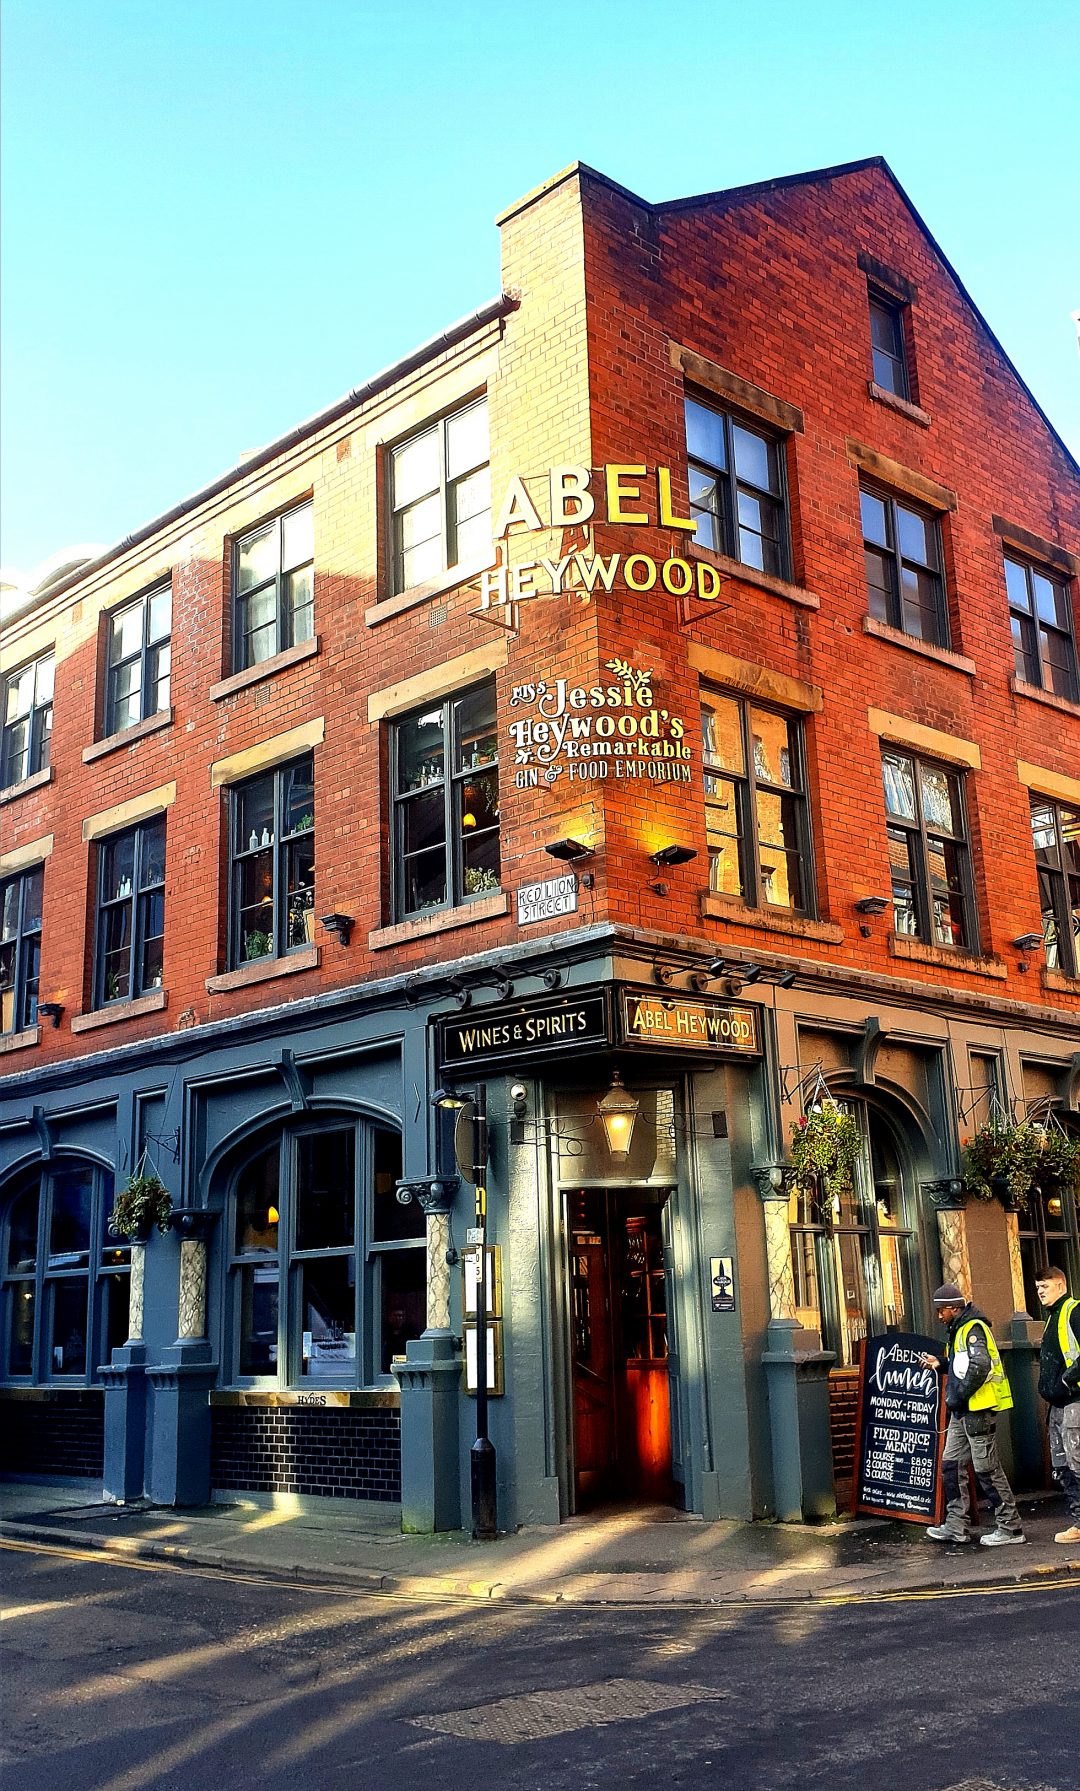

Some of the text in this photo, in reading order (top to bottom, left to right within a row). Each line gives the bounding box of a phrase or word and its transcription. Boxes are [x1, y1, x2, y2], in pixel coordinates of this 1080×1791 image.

[496, 463, 698, 536] ABEL
[475, 553, 721, 611] HEYWOOD
[538, 679, 653, 718] Jessie
[509, 709, 684, 763] Heywood's
[563, 739, 692, 760] Remarkable
[515, 760, 692, 788] GIN & FOOD EMPORIUM
[519, 877, 574, 906] RED LION
[524, 895, 569, 920] STREET
[459, 1011, 587, 1053] WINES & SPIRITS
[633, 1007, 750, 1039] ABEL HEYWOOD
[297, 1392, 326, 1405] HYDES
[873, 1427, 930, 1446] FIXED PRICE
[884, 1441, 916, 1453] MENU
[866, 1459, 871, 1468] 2
[872, 1460, 895, 1471] COURSE
[872, 1451, 895, 1462] COURSE
[911, 1457, 933, 1467] £8.95
[865, 1468, 871, 1477] 3
[871, 1470, 894, 1481] COURSE
